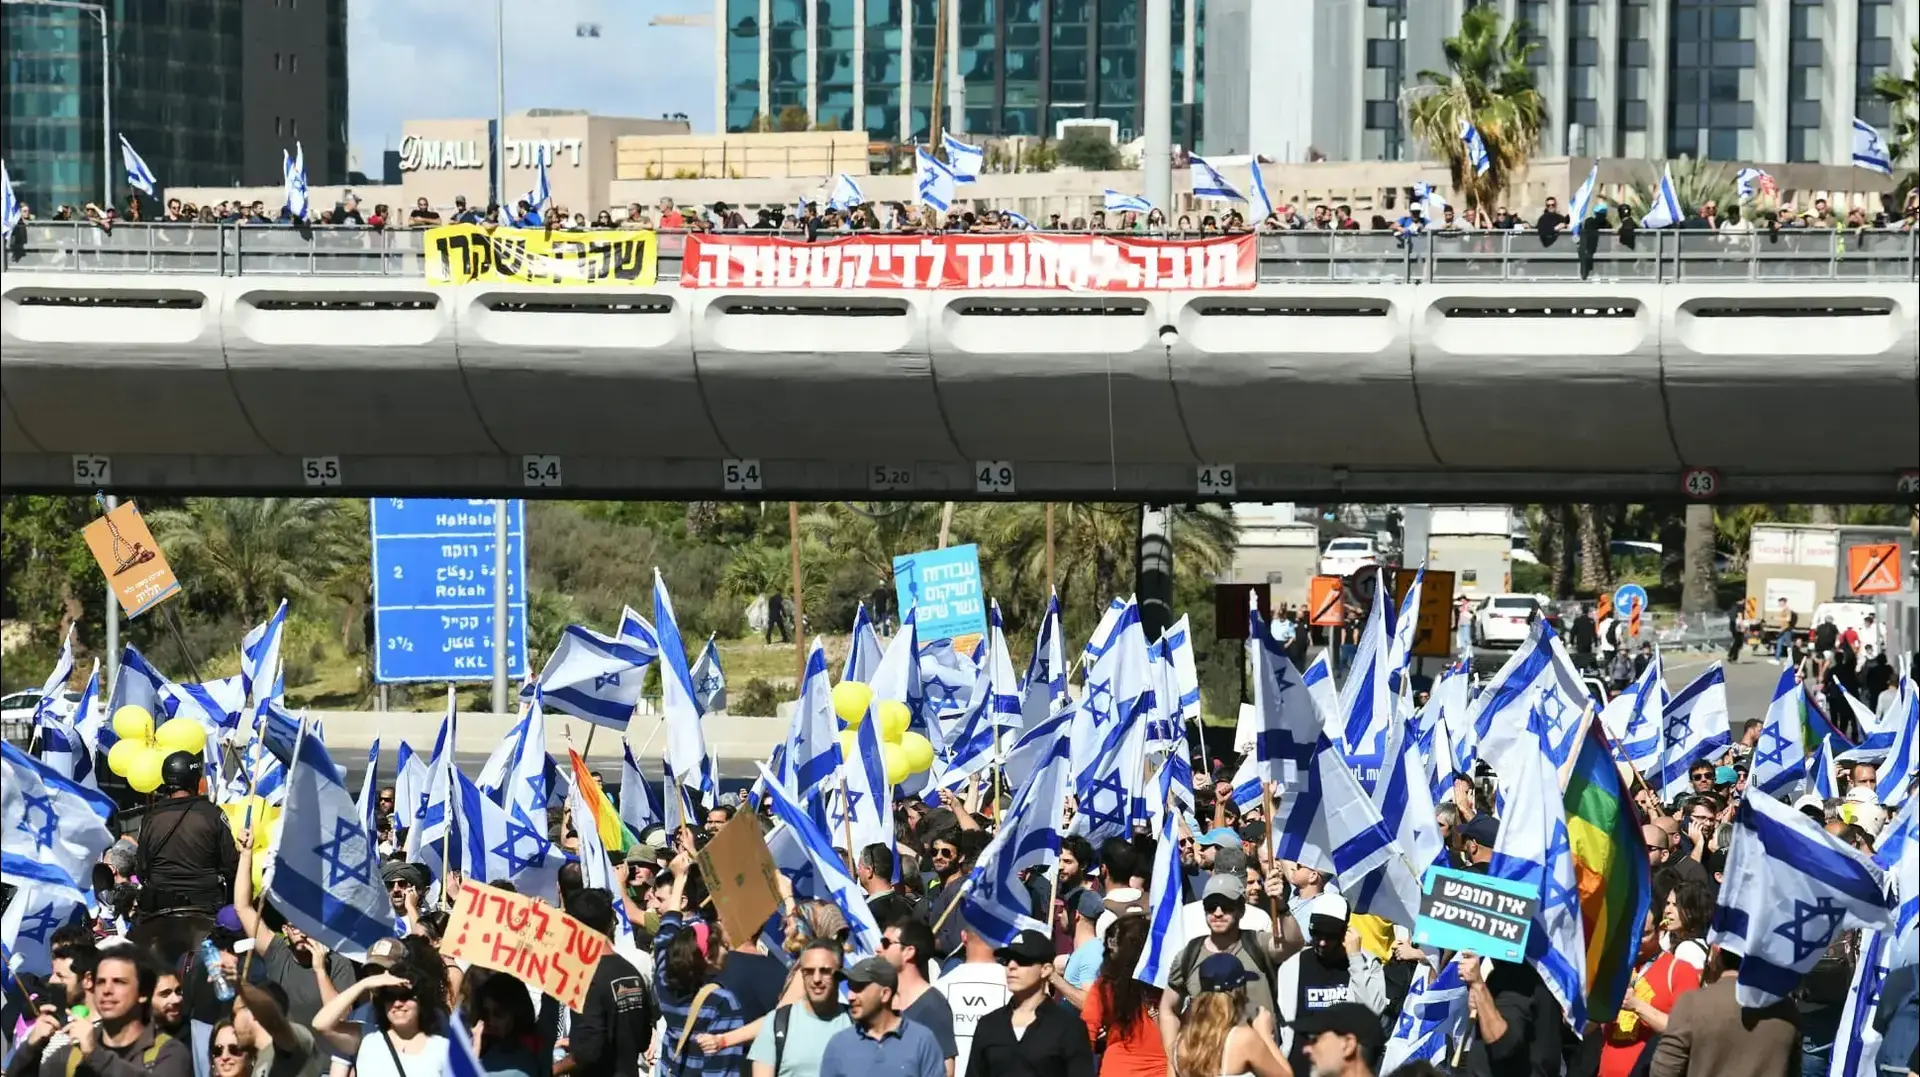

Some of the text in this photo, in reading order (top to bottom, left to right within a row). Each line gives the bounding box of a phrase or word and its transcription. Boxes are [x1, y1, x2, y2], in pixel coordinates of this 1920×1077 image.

[699, 239, 947, 289] לדיקטטורה
[77, 460, 108, 478] 5.7
[307, 461, 338, 479] 5.5
[527, 462, 558, 479] 5.4
[727, 465, 758, 483] 5.4
[874, 465, 911, 484] 5.20
[978, 467, 1012, 486] 4.9
[1200, 469, 1232, 487] 4.9
[393, 566, 403, 578] 2
[923, 561, 975, 583] עבודות
[436, 584, 486, 598] Rokah
[925, 577, 977, 604] לשיקום
[454, 656, 488, 669] KKL
[1443, 881, 1527, 916] אין חופש
[461, 884, 550, 941] לטרור
[1429, 901, 1519, 940] אין הייטק
[562, 916, 602, 965] שר
